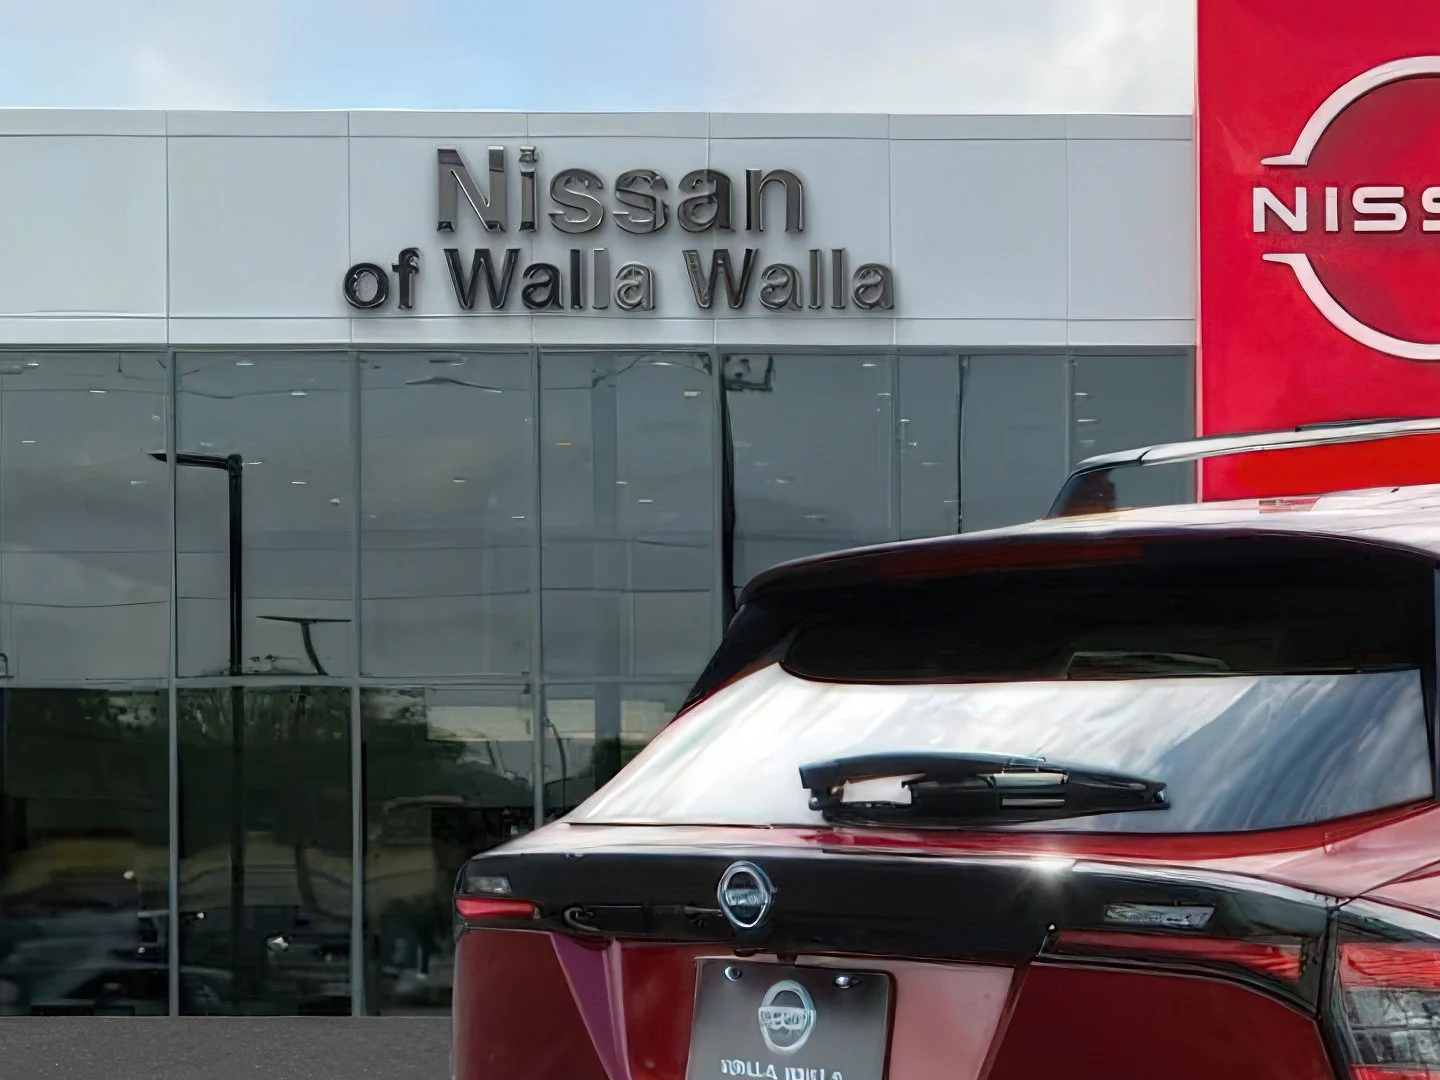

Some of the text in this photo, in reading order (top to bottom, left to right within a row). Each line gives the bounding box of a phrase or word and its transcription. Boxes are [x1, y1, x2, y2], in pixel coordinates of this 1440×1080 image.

[436, 145, 805, 234] Nissan
[342, 247, 896, 311] of Walla Walla
